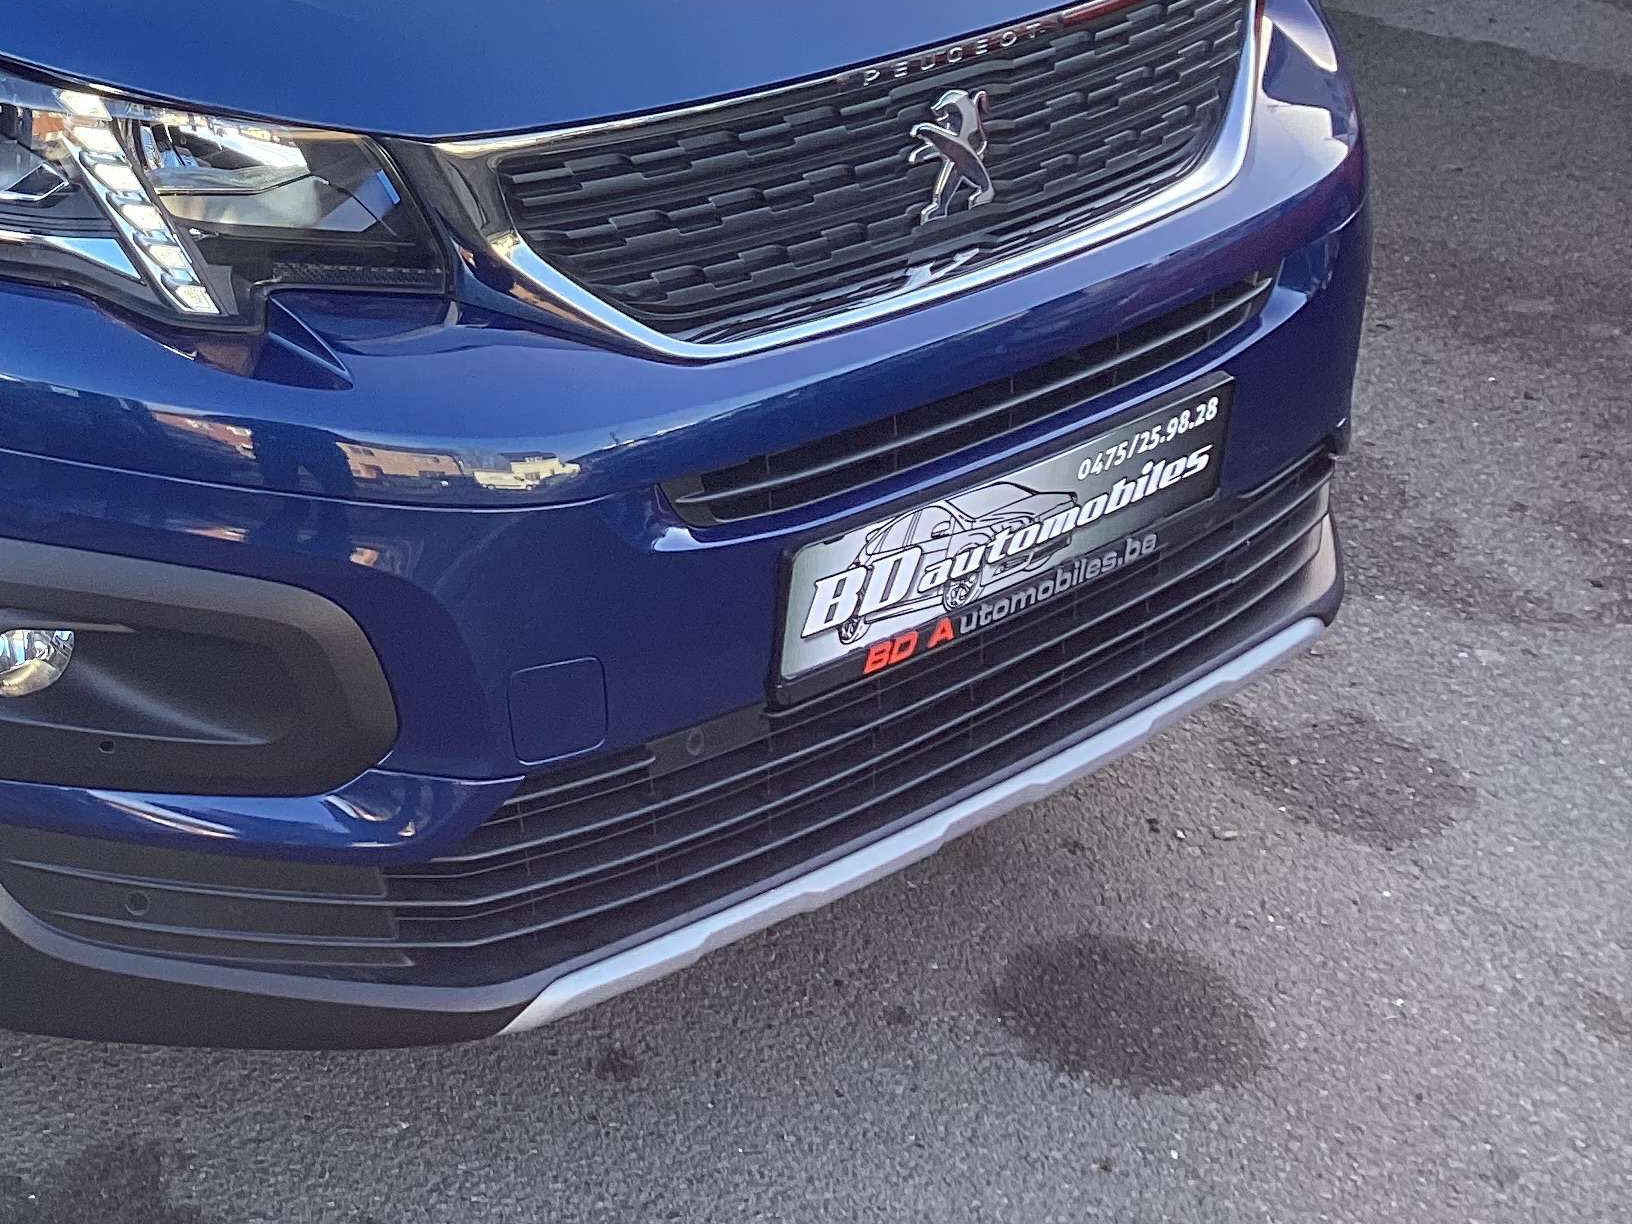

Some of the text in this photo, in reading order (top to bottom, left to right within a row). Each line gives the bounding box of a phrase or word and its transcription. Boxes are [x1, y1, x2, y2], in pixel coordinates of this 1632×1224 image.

[863, 22, 1043, 87] PEUGEOT
[1077, 396, 1219, 481] 0475/25.98.28
[863, 630, 919, 675] BD
